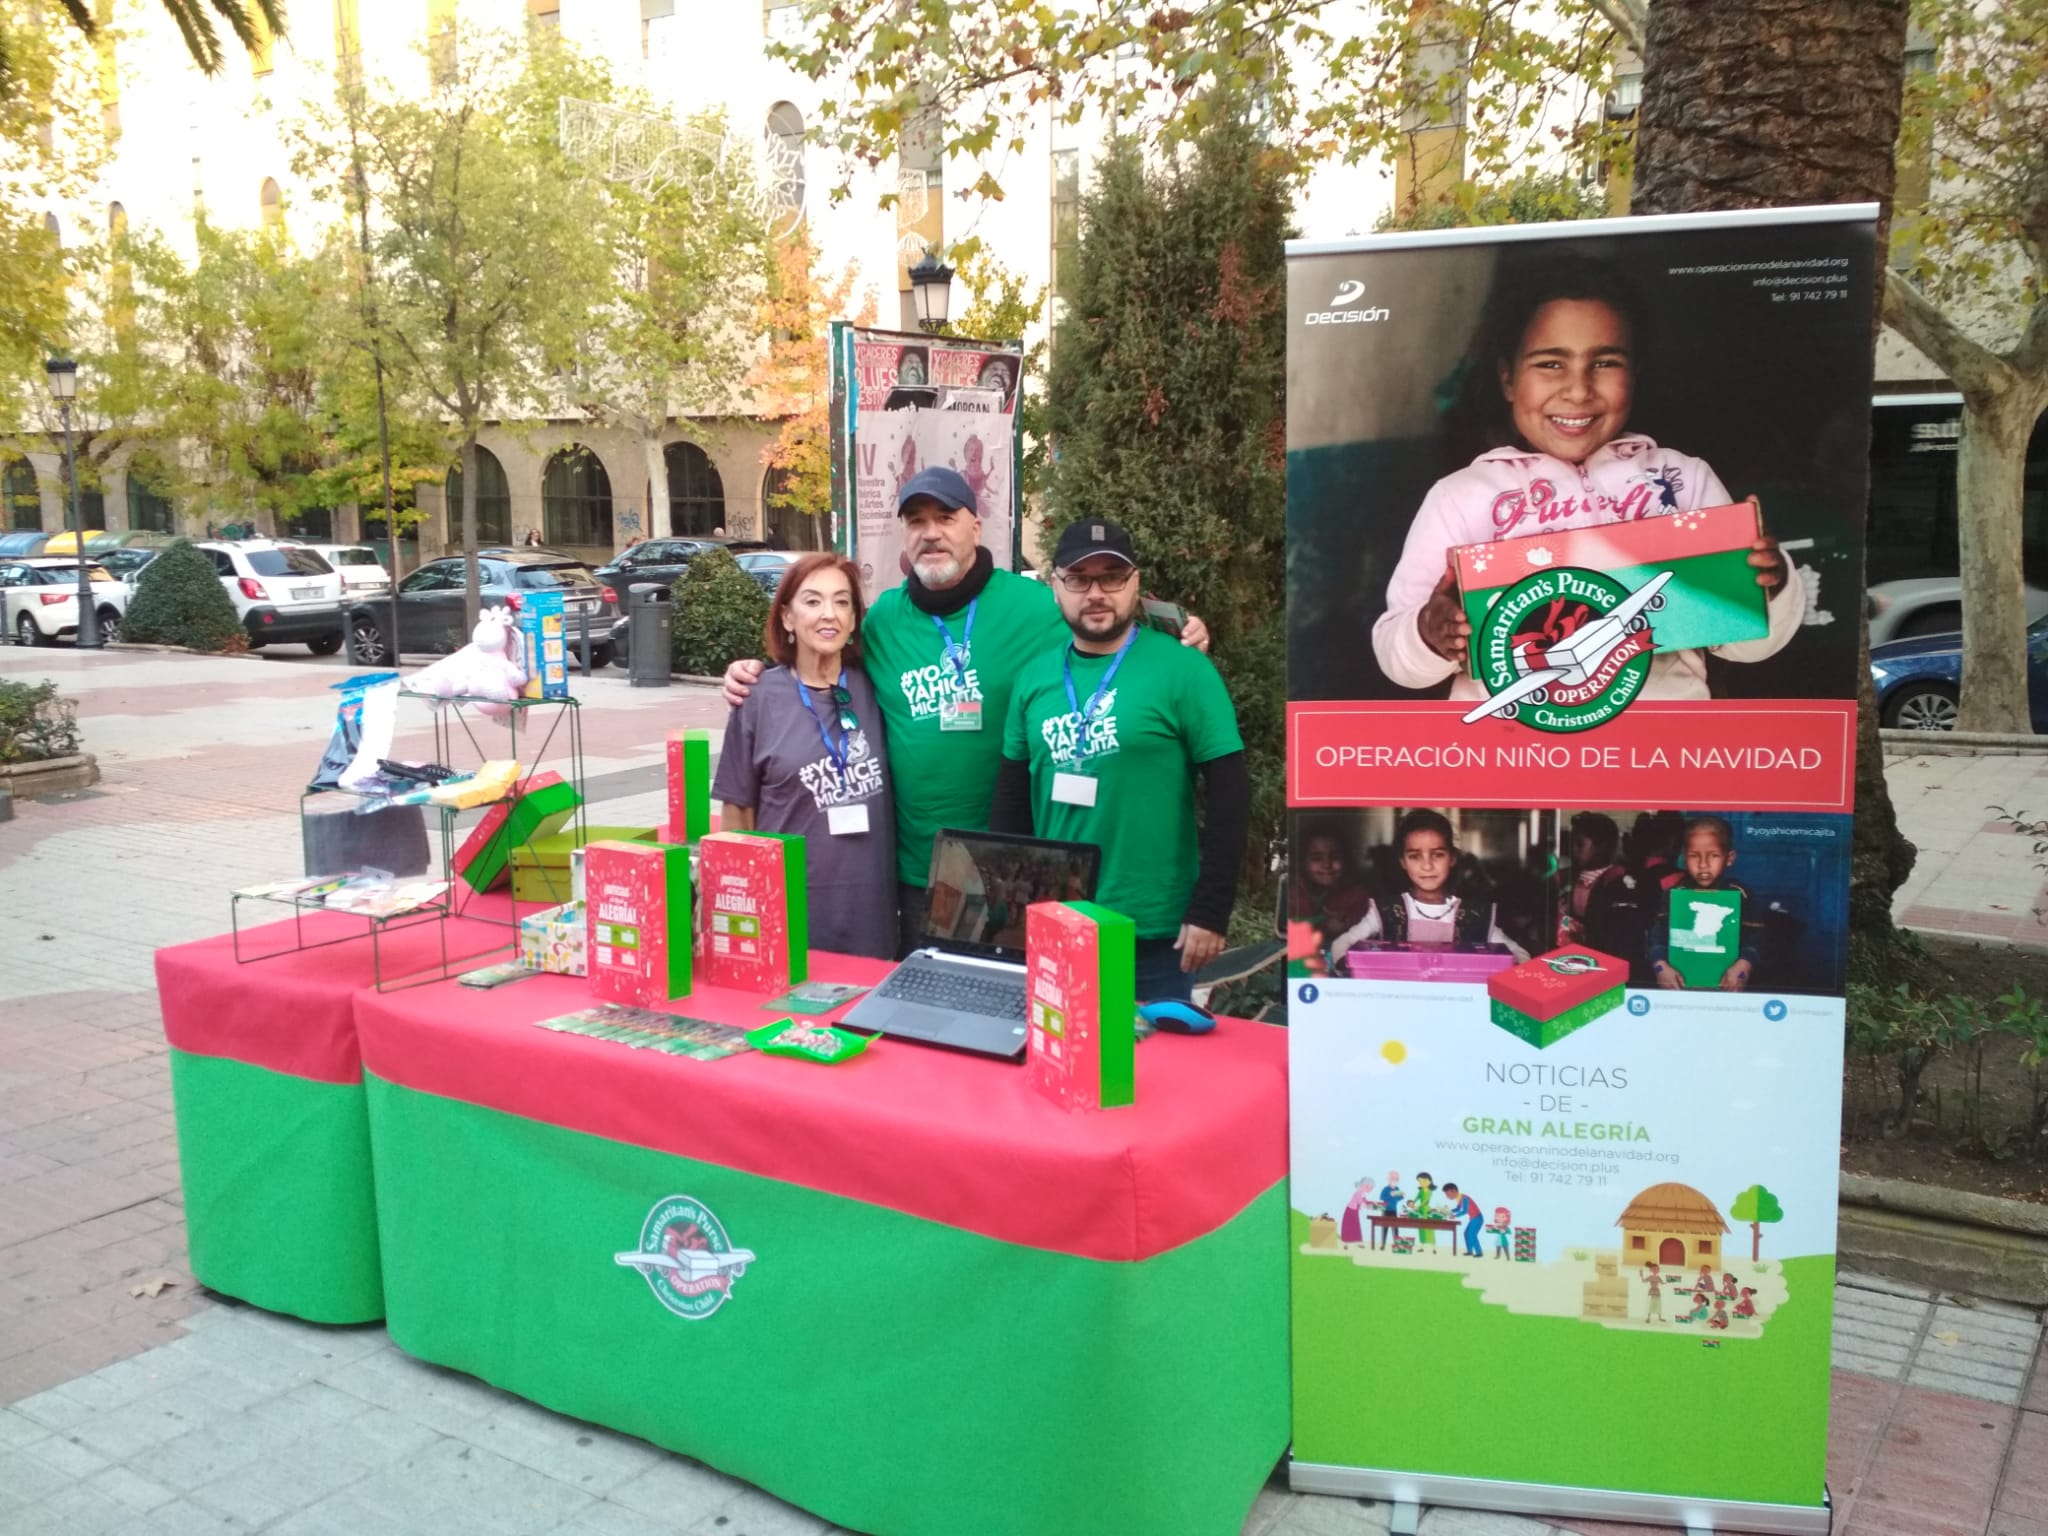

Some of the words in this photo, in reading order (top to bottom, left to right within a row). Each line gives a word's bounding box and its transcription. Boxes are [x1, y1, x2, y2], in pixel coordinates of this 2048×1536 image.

[1753, 274, 1848, 287] info@decision.plus
[1789, 291, 1801, 302] 91
[1803, 290, 1822, 301] 742
[1825, 290, 1838, 300] 79
[1490, 579, 1554, 688] Samaritan's
[1556, 572, 1617, 609] Purse
[900, 664, 941, 689] #YO
[1553, 639, 1642, 704] OPERATION
[902, 668, 980, 705] YAHICE
[1534, 704, 1612, 728] Christmas
[1609, 668, 1642, 706] Child
[1041, 711, 1083, 737] #YO
[1315, 741, 1487, 768] OPERACIÓN
[1495, 743, 1571, 769] NIÑO
[1581, 746, 1621, 769] DE
[1630, 747, 1671, 769] LA
[1680, 747, 1823, 771] NAVIDAD
[1485, 1062, 1629, 1090] NOTICIAS
[1539, 1094, 1573, 1113] DE
[1462, 1116, 1533, 1137] GRAN
[1541, 1121, 1652, 1143] ALEGRÍA
[1434, 1140, 1681, 1164] www.operacionninodelanavidad.org
[1492, 1158, 1620, 1174] info@decision.plus
[1529, 1172, 1545, 1183] 91
[1548, 1173, 1573, 1185] 742
[1577, 1175, 1594, 1186] 79
[1598, 1176, 1608, 1187] 11
[696, 1211, 723, 1252] Purse
[669, 1276, 721, 1295] OPERATION
[694, 1293, 715, 1312] Child
